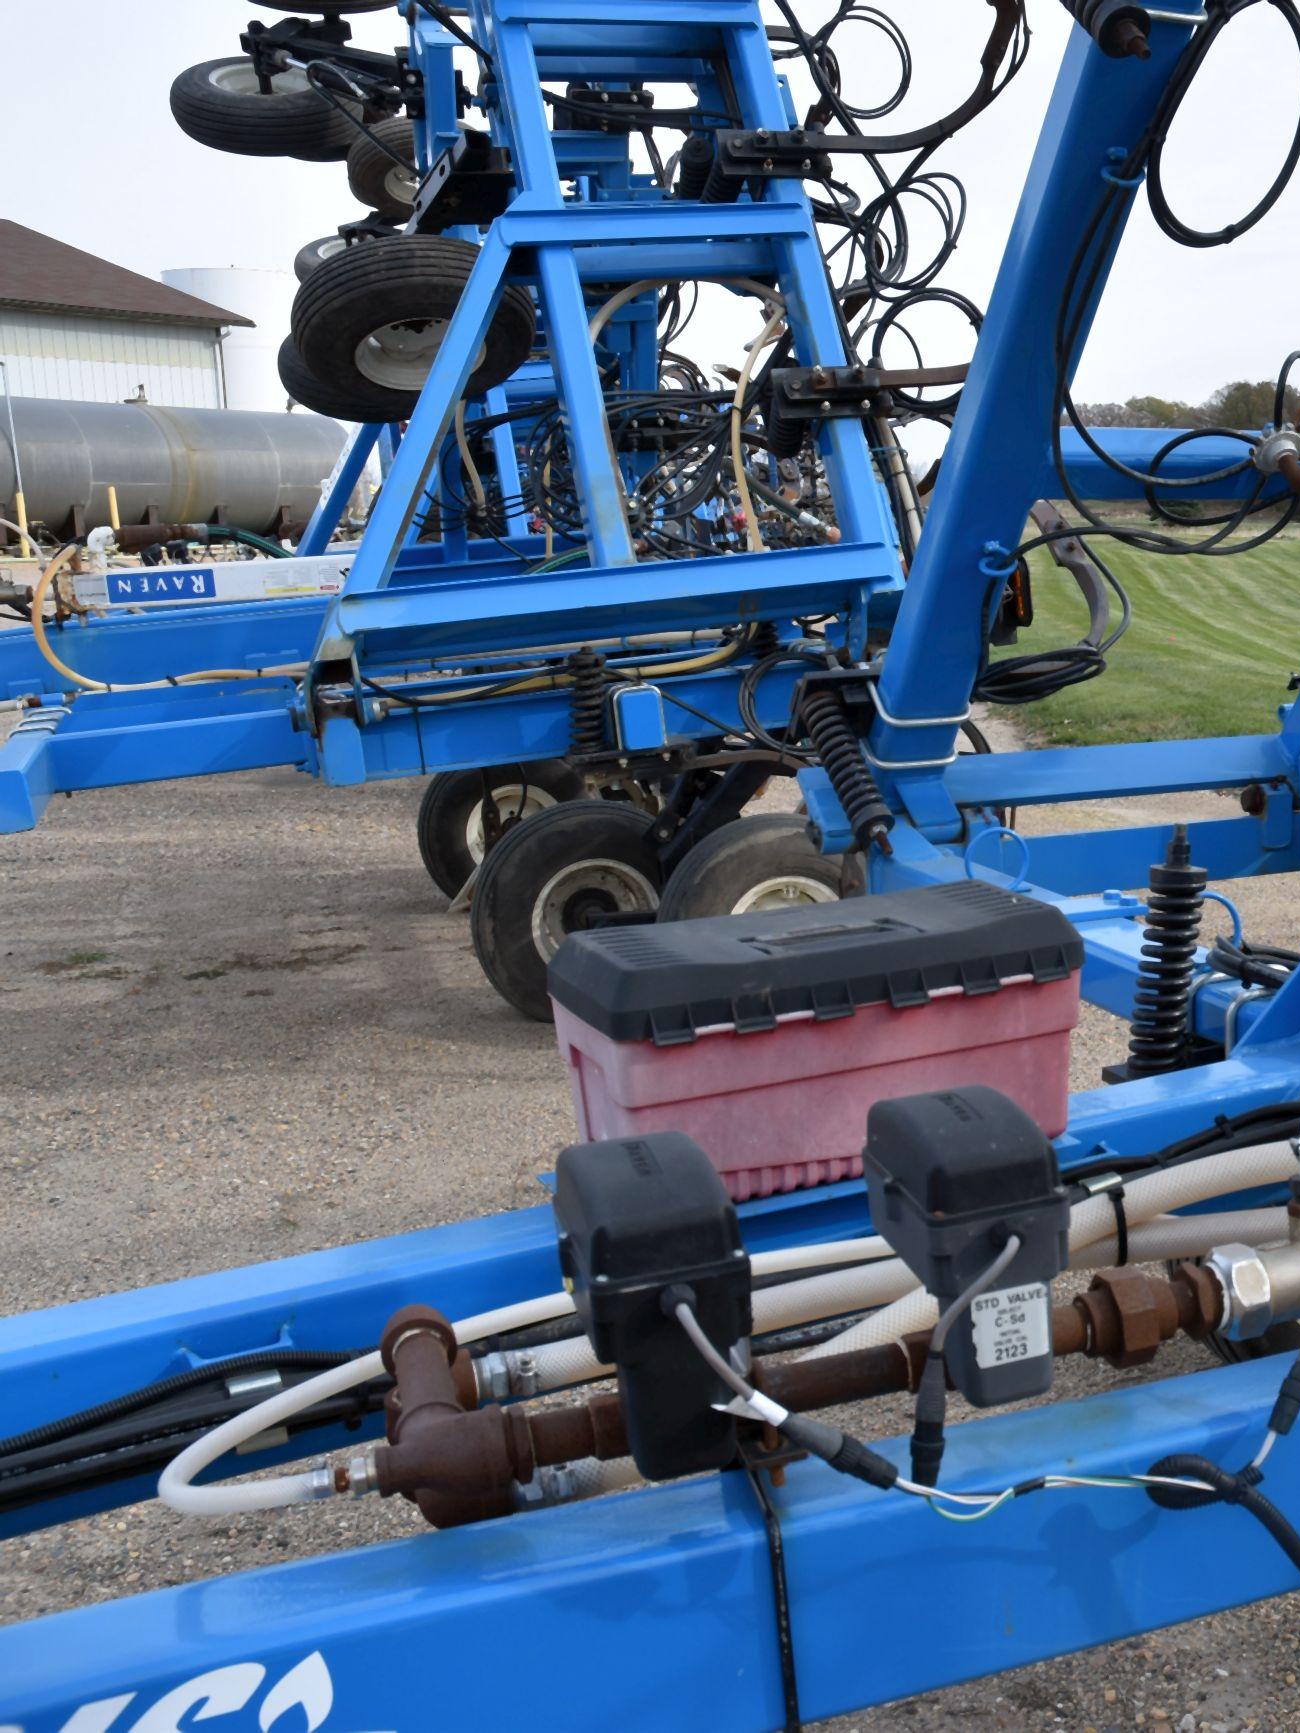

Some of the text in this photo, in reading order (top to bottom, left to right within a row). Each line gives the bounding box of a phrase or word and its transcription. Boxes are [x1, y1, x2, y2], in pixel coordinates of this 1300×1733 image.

[118, 575, 205, 594] RAVEN
[975, 1288, 1043, 1312] STD VALVE
[994, 1342, 1028, 1361] 2123
